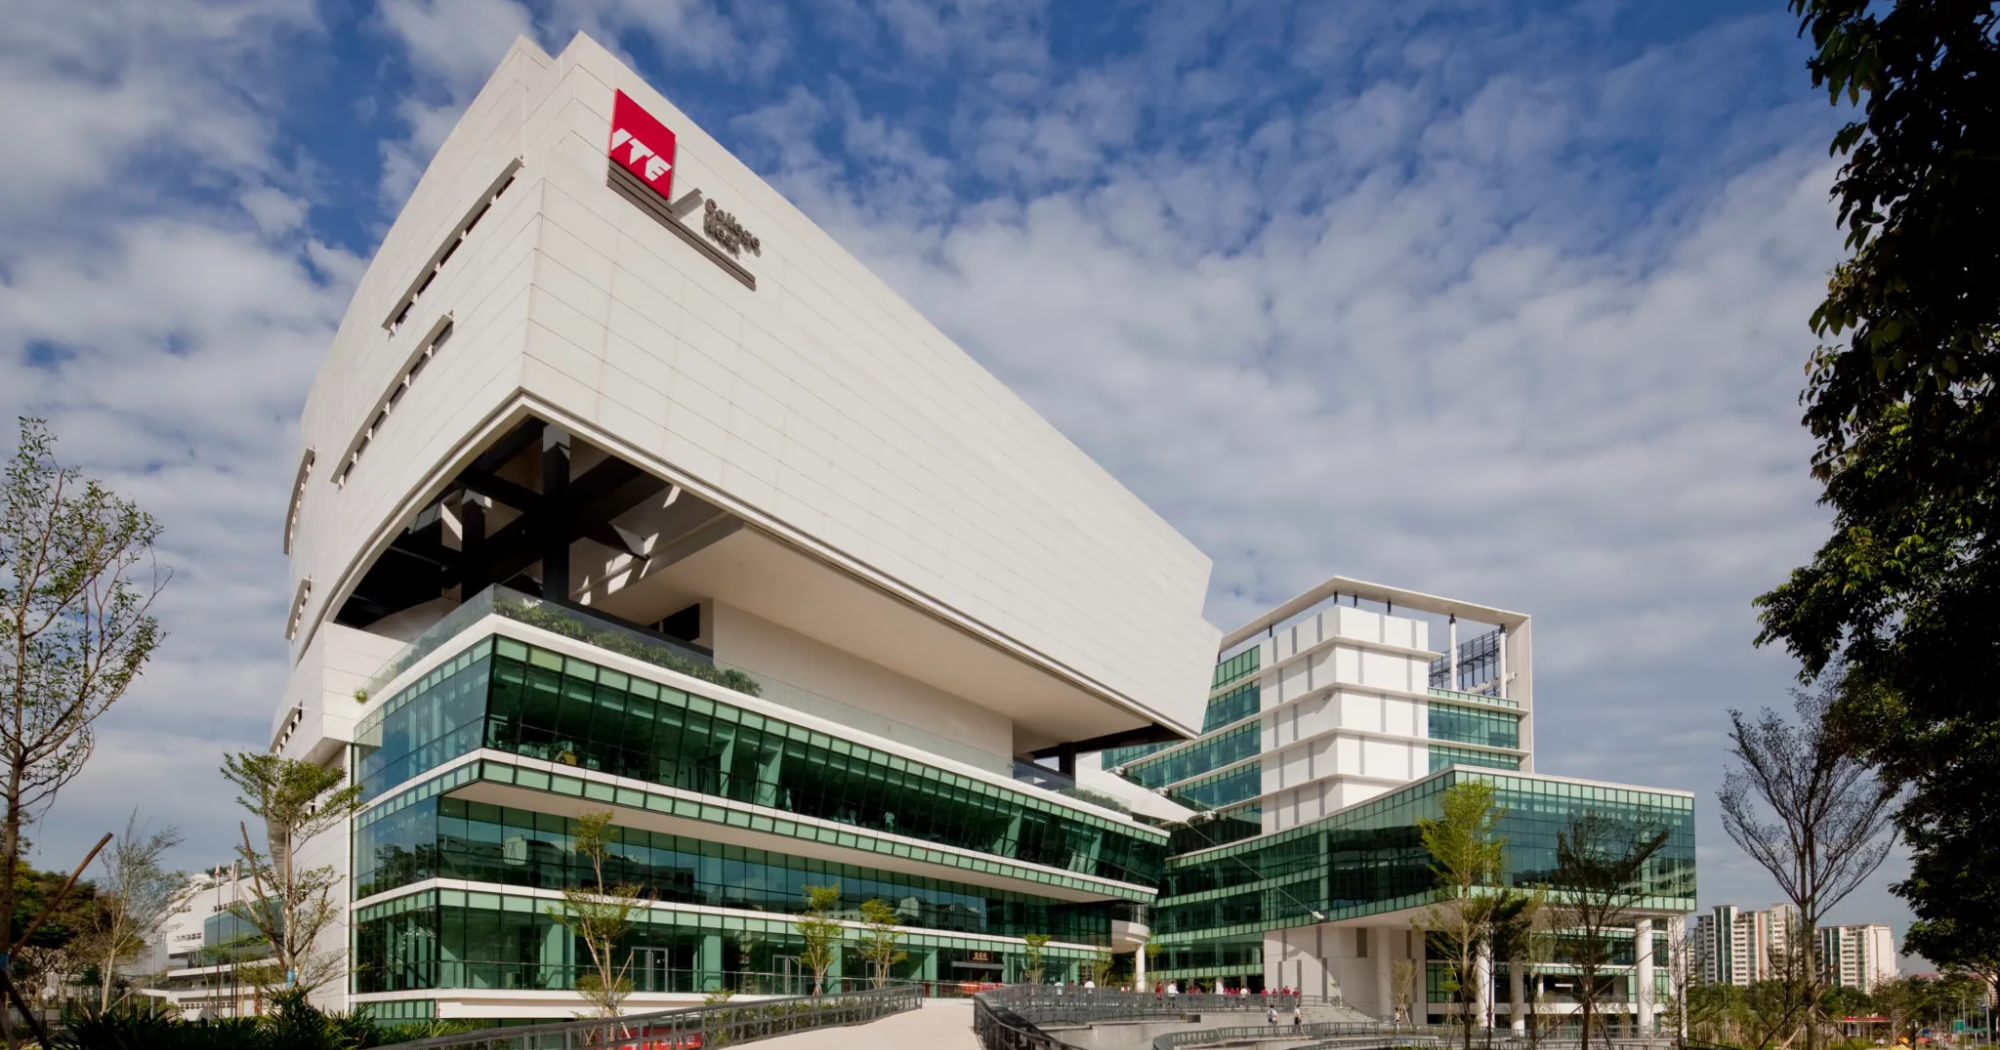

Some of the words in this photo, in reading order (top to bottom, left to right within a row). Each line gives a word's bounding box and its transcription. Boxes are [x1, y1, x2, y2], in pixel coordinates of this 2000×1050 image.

[610, 127, 672, 181] ITE
[703, 213, 740, 255] West
[704, 198, 761, 252] College
